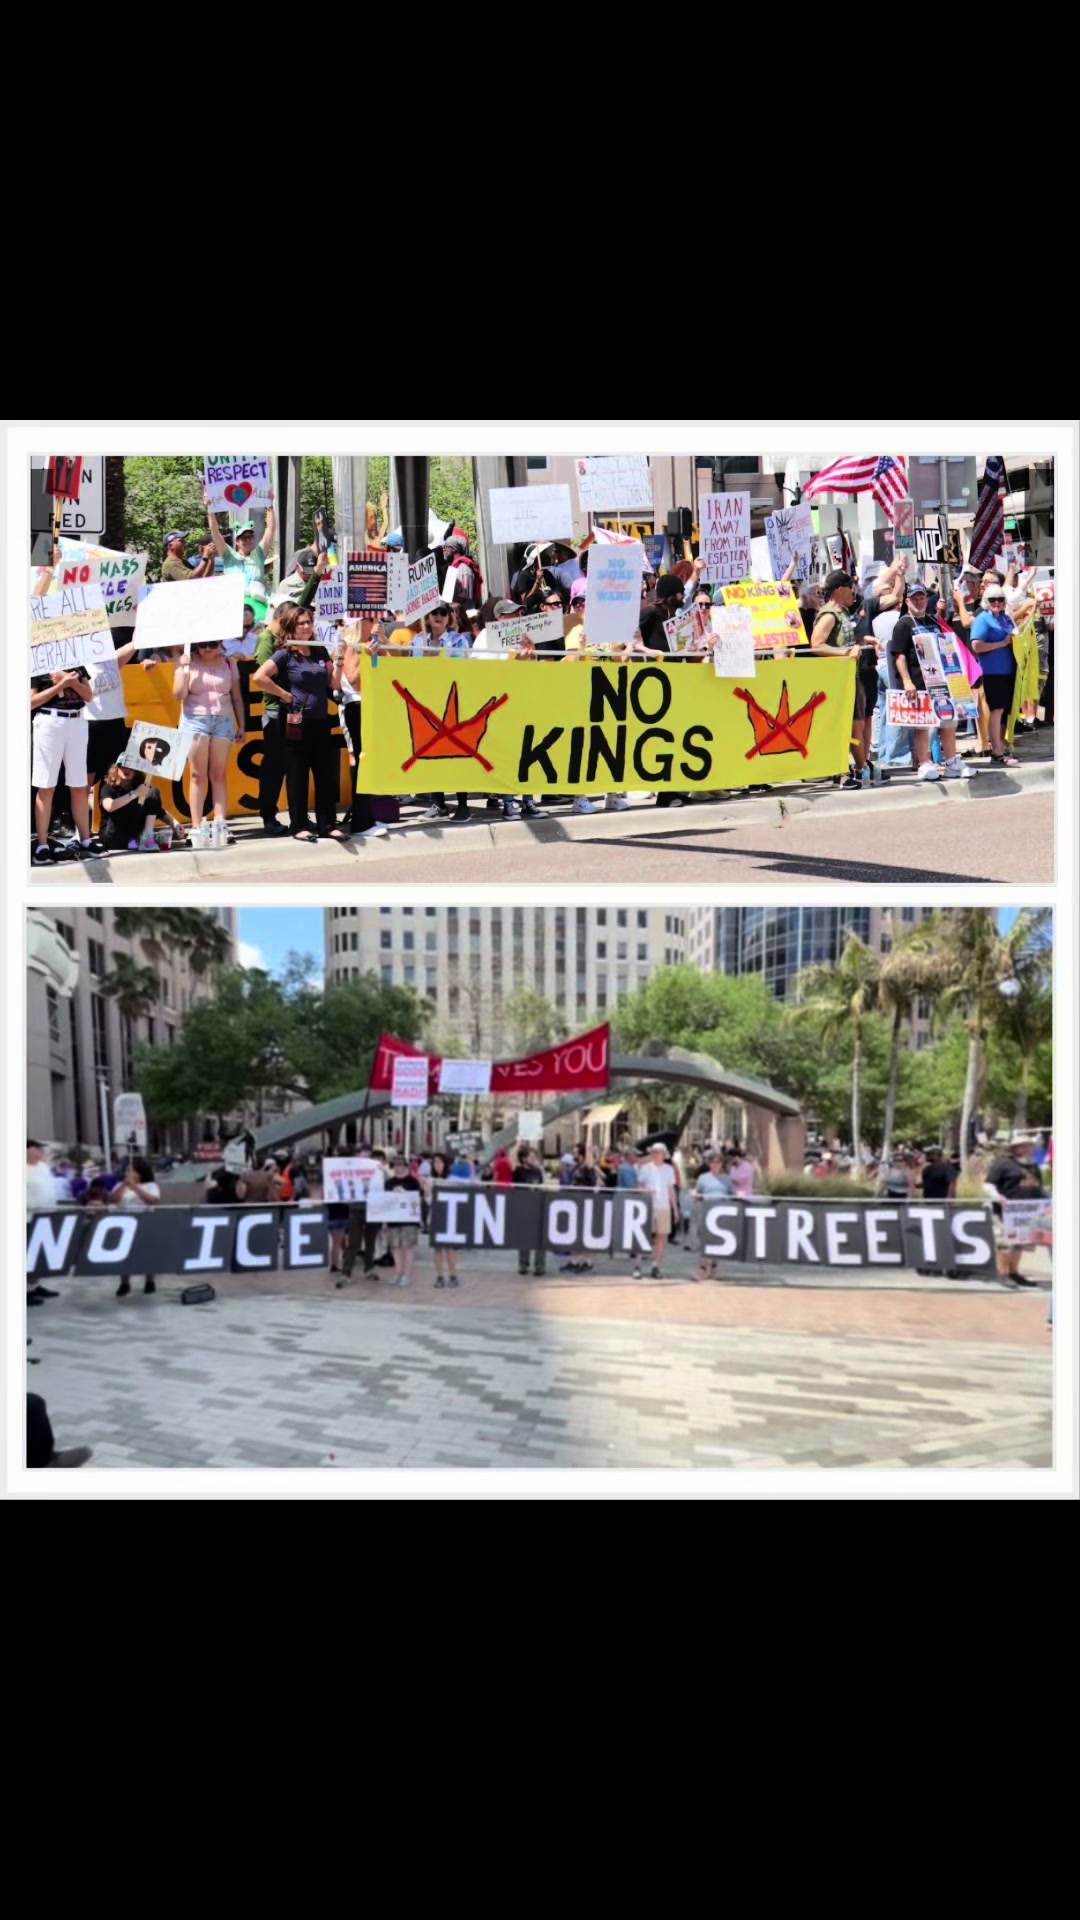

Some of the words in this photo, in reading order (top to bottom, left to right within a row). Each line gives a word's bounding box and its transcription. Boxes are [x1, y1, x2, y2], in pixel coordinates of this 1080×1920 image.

[207, 462, 267, 484] RESPECT
[707, 498, 743, 520] IRAN
[709, 520, 740, 535] AWAY
[704, 537, 731, 552] FROM
[733, 536, 749, 548] THE
[915, 529, 943, 561] NOP
[63, 565, 91, 584] NO
[348, 564, 387, 572] AMERICA
[706, 560, 750, 580] FILES!
[61, 586, 91, 614] ALL
[726, 587, 746, 600] NO
[501, 634, 521, 648] FREE
[590, 665, 672, 724] NO
[889, 692, 926, 709] FIGHT
[889, 711, 936, 723] FASCISM
[518, 724, 713, 784] KINGS
[552, 1038, 607, 1075] YOU
[27, 1214, 138, 1274] NO
[183, 1213, 324, 1269] ICE
[434, 1191, 506, 1246] IN
[547, 1199, 653, 1252] OUR
[704, 1205, 992, 1266] STREETS
